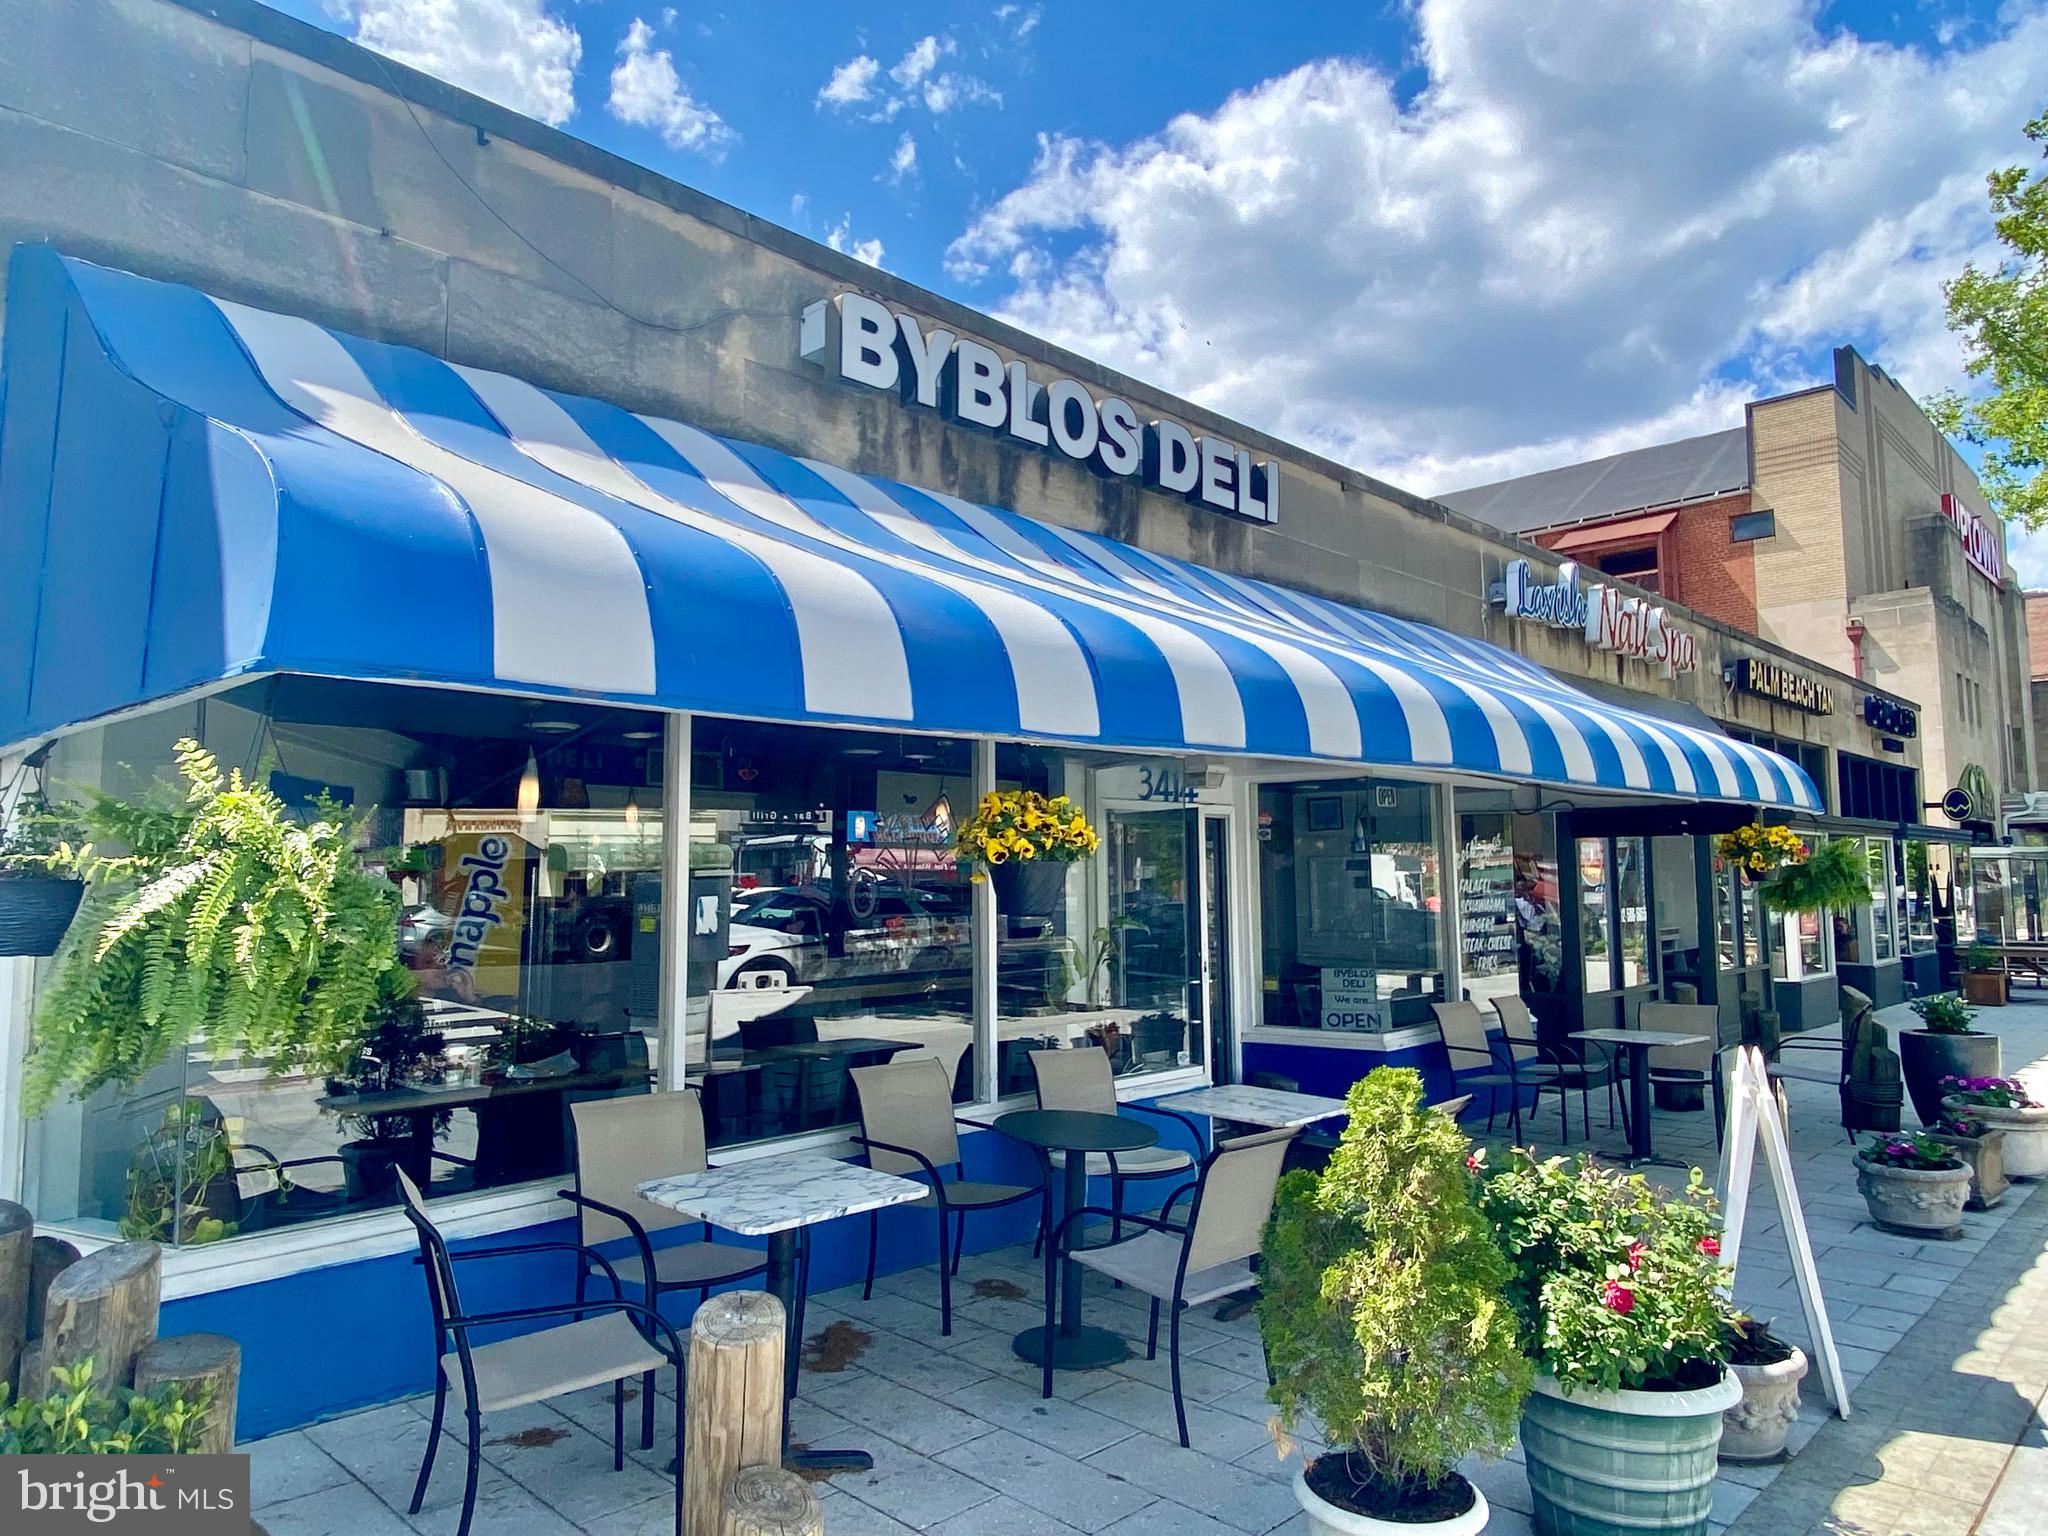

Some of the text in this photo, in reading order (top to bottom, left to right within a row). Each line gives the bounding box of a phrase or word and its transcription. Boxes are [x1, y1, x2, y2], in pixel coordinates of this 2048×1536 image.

[837, 291, 1280, 524] BYBLOS DELI
[1949, 493, 2001, 580] UPTOWN
[1508, 559, 1698, 680] Lavish Nail Spa
[1748, 659, 1835, 715] PALM BEACH TAN
[1137, 766, 1199, 803] 3414
[1378, 788, 1395, 806] OPEN
[1459, 878, 1491, 894] FALAFEL
[448, 838, 508, 992] napple
[1461, 916, 1496, 933] BURGERS
[1461, 937, 1484, 954] STEAK
[1487, 934, 1513, 951] CHEESE
[1333, 969, 1376, 978] BYBLOS
[1342, 979, 1366, 988] DELI
[1334, 995, 1351, 1004] We
[1326, 1013, 1382, 1029] OPEN
